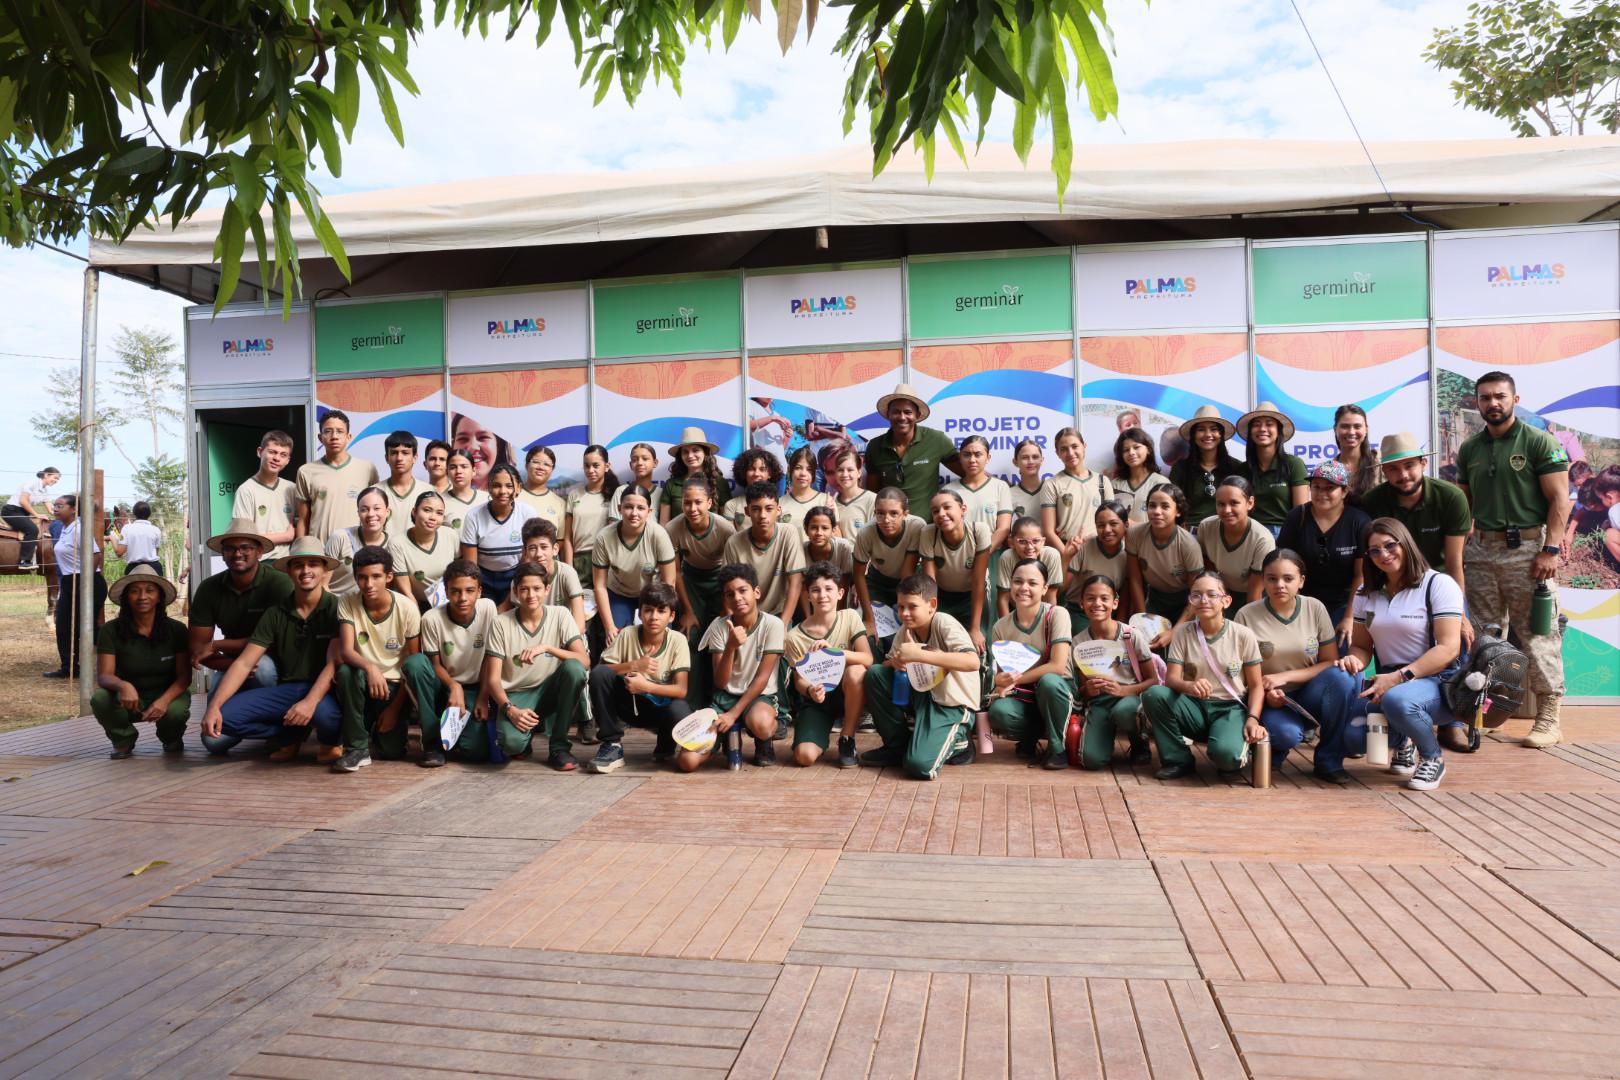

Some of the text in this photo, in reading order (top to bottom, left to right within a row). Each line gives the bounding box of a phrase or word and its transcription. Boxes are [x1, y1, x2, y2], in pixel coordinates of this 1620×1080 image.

[1488, 263, 1565, 282] PALMAS
[1126, 277, 1196, 295] PALMAS
[1303, 278, 1376, 300] germinar
[791, 295, 857, 314] PALMAS
[955, 291, 1024, 312] germinar
[488, 317, 546, 335] PALMAS
[636, 313, 698, 334] germinar
[223, 338, 274, 354] PALMAS
[351, 331, 406, 351] germinar
[945, 416, 1041, 433] PROJETO
